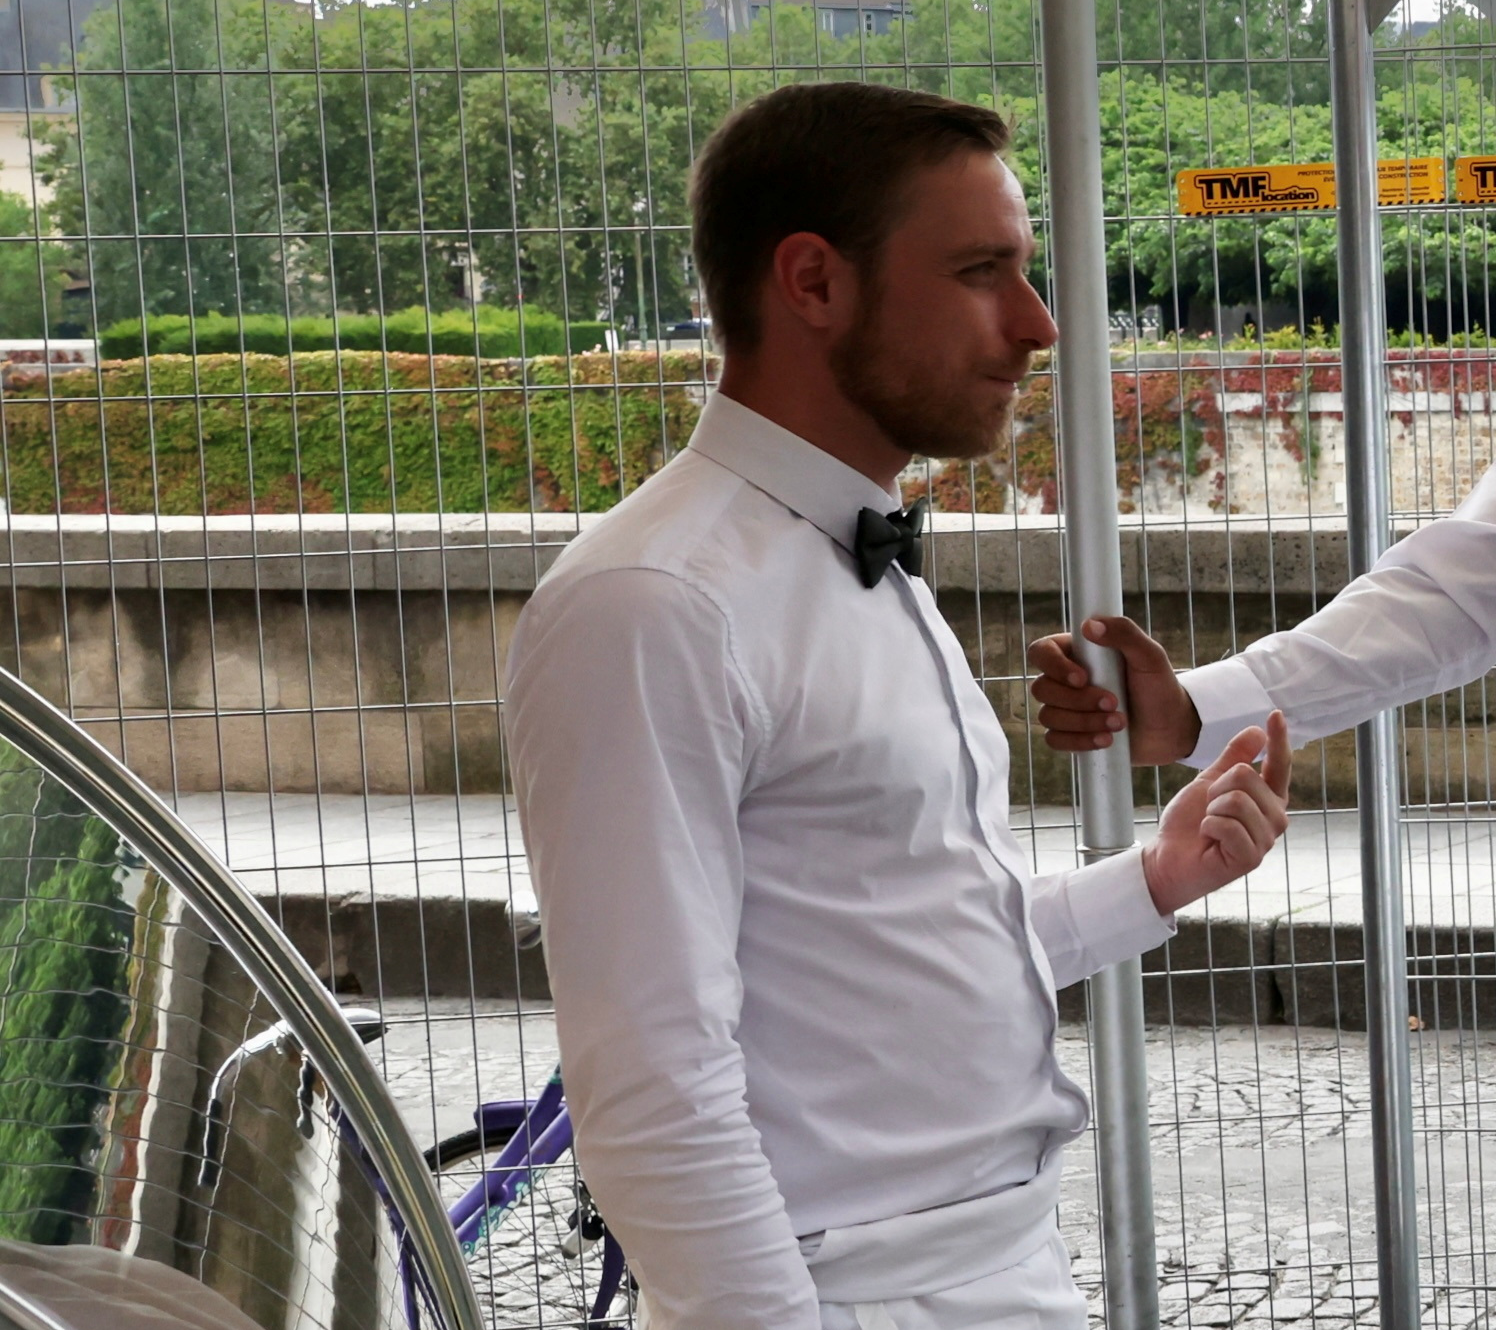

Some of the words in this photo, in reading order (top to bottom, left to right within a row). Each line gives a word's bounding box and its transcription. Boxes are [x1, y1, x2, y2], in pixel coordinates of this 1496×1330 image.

[1378, 171, 1429, 180] CONSTRCTION
[1198, 175, 1267, 200] TMF
[1261, 190, 1316, 202] location
